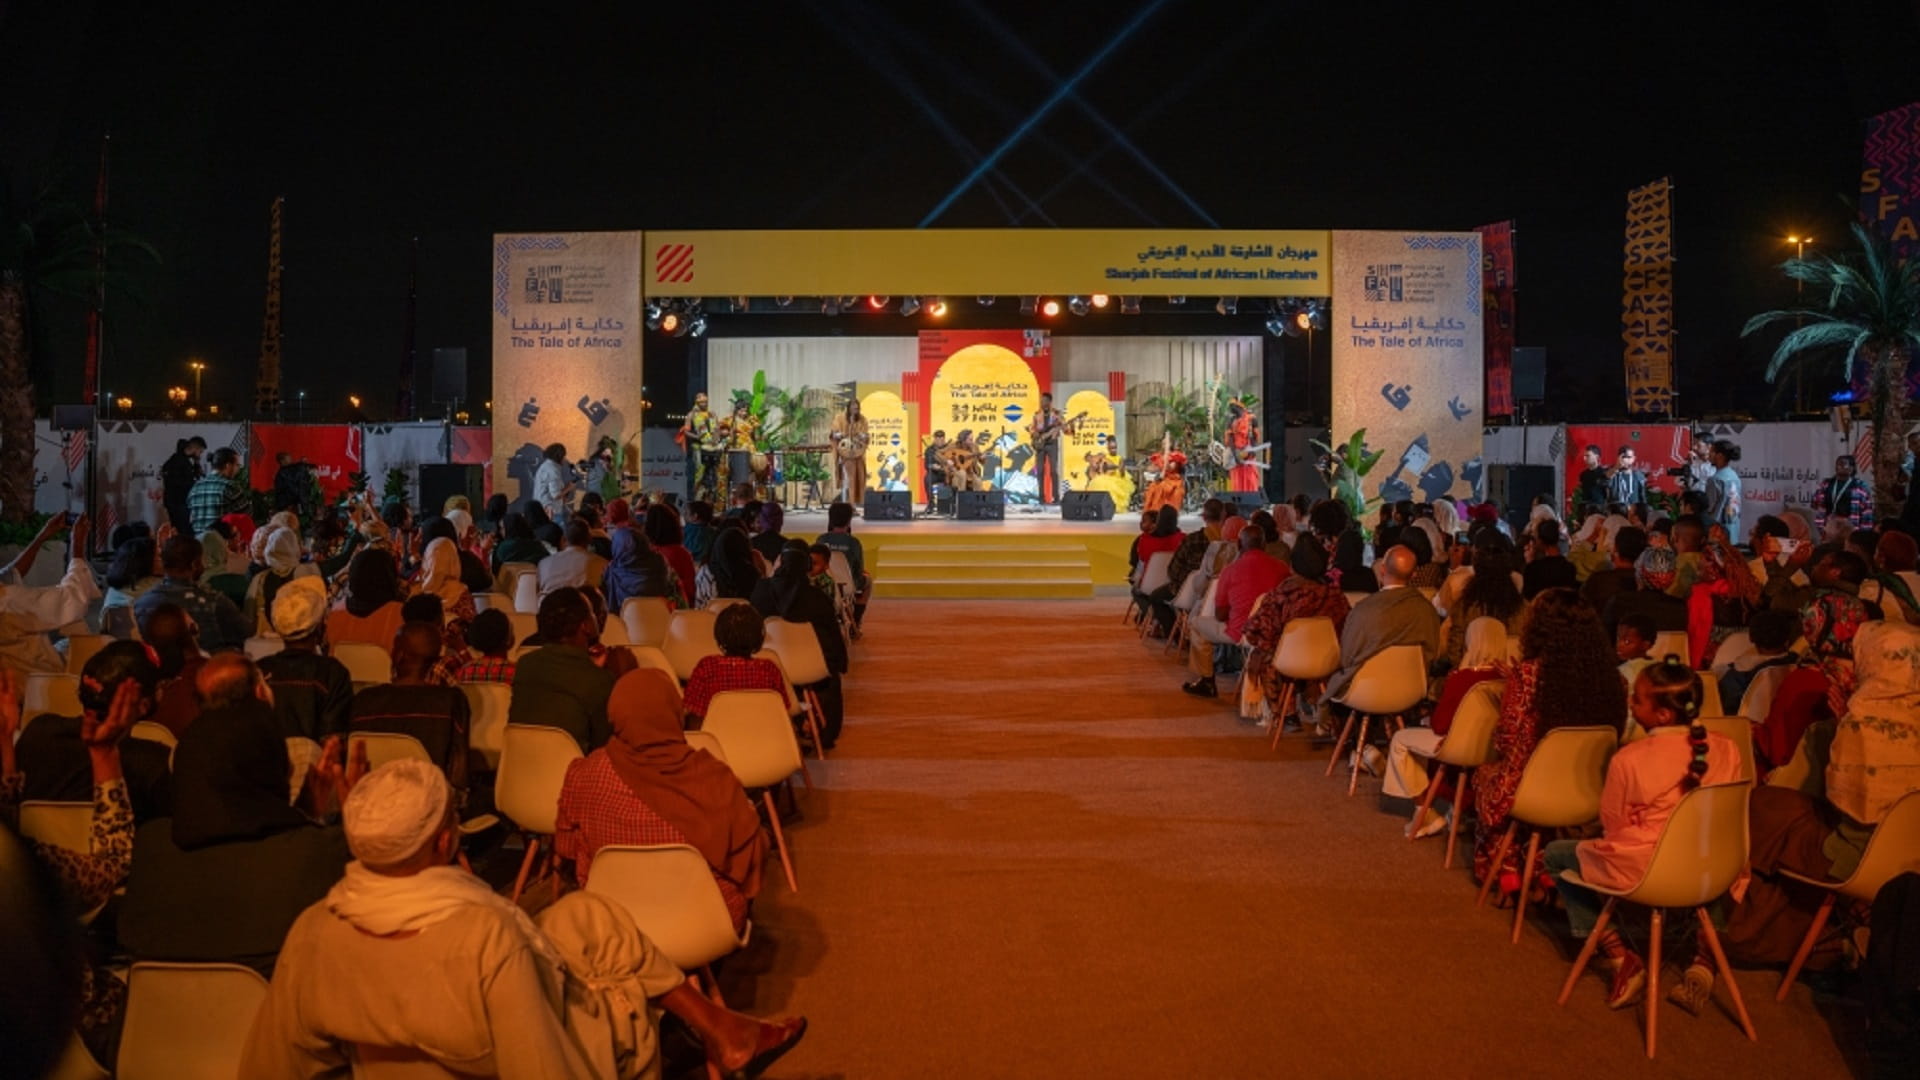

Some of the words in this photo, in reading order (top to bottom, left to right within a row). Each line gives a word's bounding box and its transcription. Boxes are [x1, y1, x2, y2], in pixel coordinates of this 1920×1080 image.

[1229, 245, 1273, 260] الشارقة
[1277, 246, 1318, 261] مهرجان
[1105, 267, 1150, 281] Sharjah
[1152, 267, 1198, 279] Festival
[1199, 267, 1212, 279] of
[1214, 267, 1258, 279] African
[1259, 267, 1318, 280] Literature
[511, 317, 572, 334] إفريقيا
[576, 317, 624, 332] حكاية
[1351, 315, 1413, 334] إفريقيا
[1416, 316, 1466, 332] حكاية
[510, 336, 535, 348] The
[539, 336, 565, 348] Tale
[567, 336, 580, 348] of
[583, 336, 622, 348] Africa
[1351, 335, 1376, 348] The
[1380, 335, 1406, 347] Tale
[1408, 335, 1421, 347] of
[1425, 335, 1465, 348] Africa
[1760, 466, 1794, 482] الشارقة
